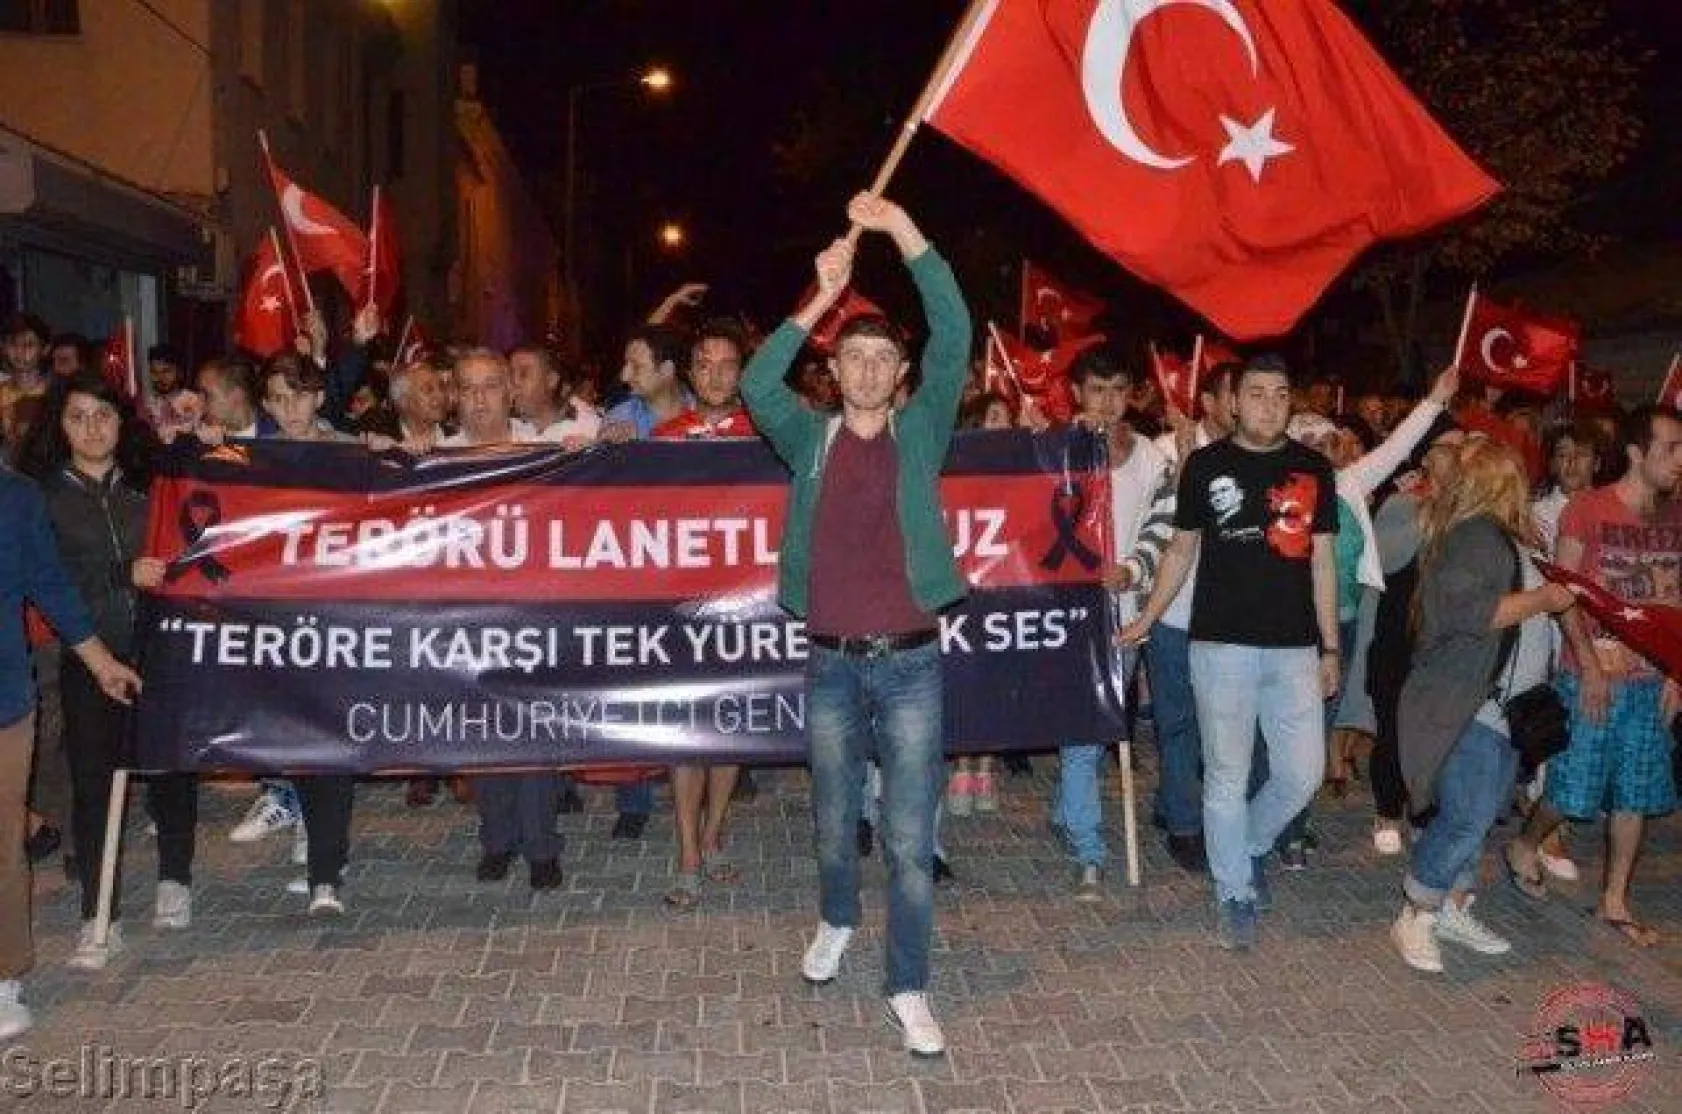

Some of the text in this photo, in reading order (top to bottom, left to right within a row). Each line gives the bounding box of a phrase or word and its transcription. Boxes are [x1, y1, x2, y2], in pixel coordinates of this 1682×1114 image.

[271, 503, 531, 568] TERÖRÜ
[549, 518, 779, 568] LANETL
[409, 626, 557, 673] KARŞI
[574, 626, 670, 667] TEK
[683, 614, 811, 663] YÜRE
[714, 692, 805, 734] GEN
